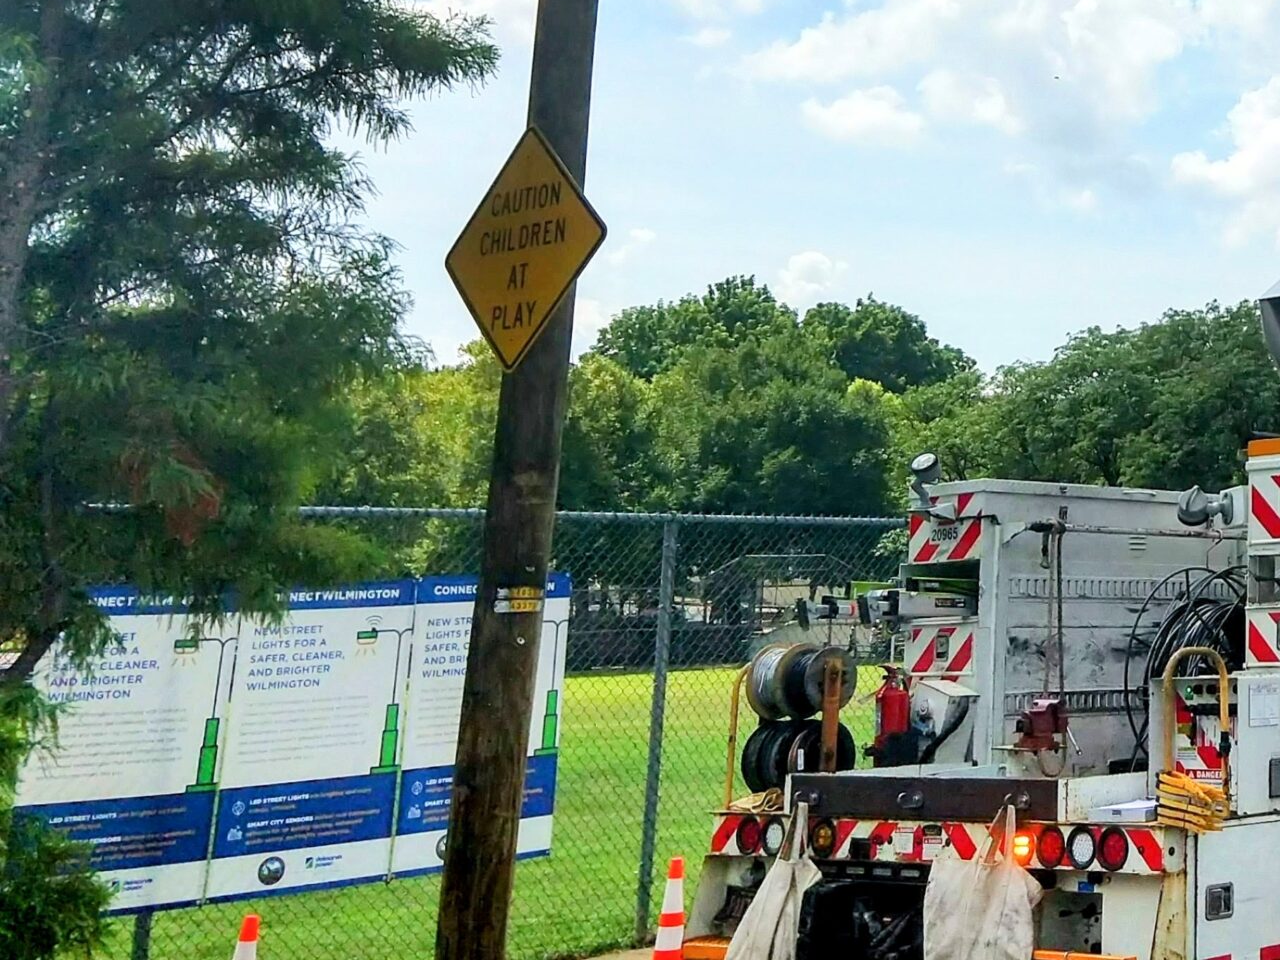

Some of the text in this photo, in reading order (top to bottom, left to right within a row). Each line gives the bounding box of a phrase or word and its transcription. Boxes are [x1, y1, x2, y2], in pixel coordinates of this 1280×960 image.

[491, 183, 561, 216] CAUTION
[479, 219, 565, 255] CHILDREN
[507, 263, 528, 289] AT
[491, 301, 536, 331] PLAY
[932, 527, 958, 542] 20965
[427, 618, 452, 627] NEW
[254, 625, 324, 636] NEW STREET
[426, 630, 461, 640] LIGHTS
[252, 638, 327, 650] LIGHTS FOR A
[292, 651, 345, 662] CLEANER,
[424, 656, 446, 665] AND
[100, 659, 160, 671] CLEANER,
[248, 665, 331, 677] AND BRIGHTER
[50, 674, 144, 688] AND BRIGHTER
[247, 679, 320, 691] WILMINGTON
